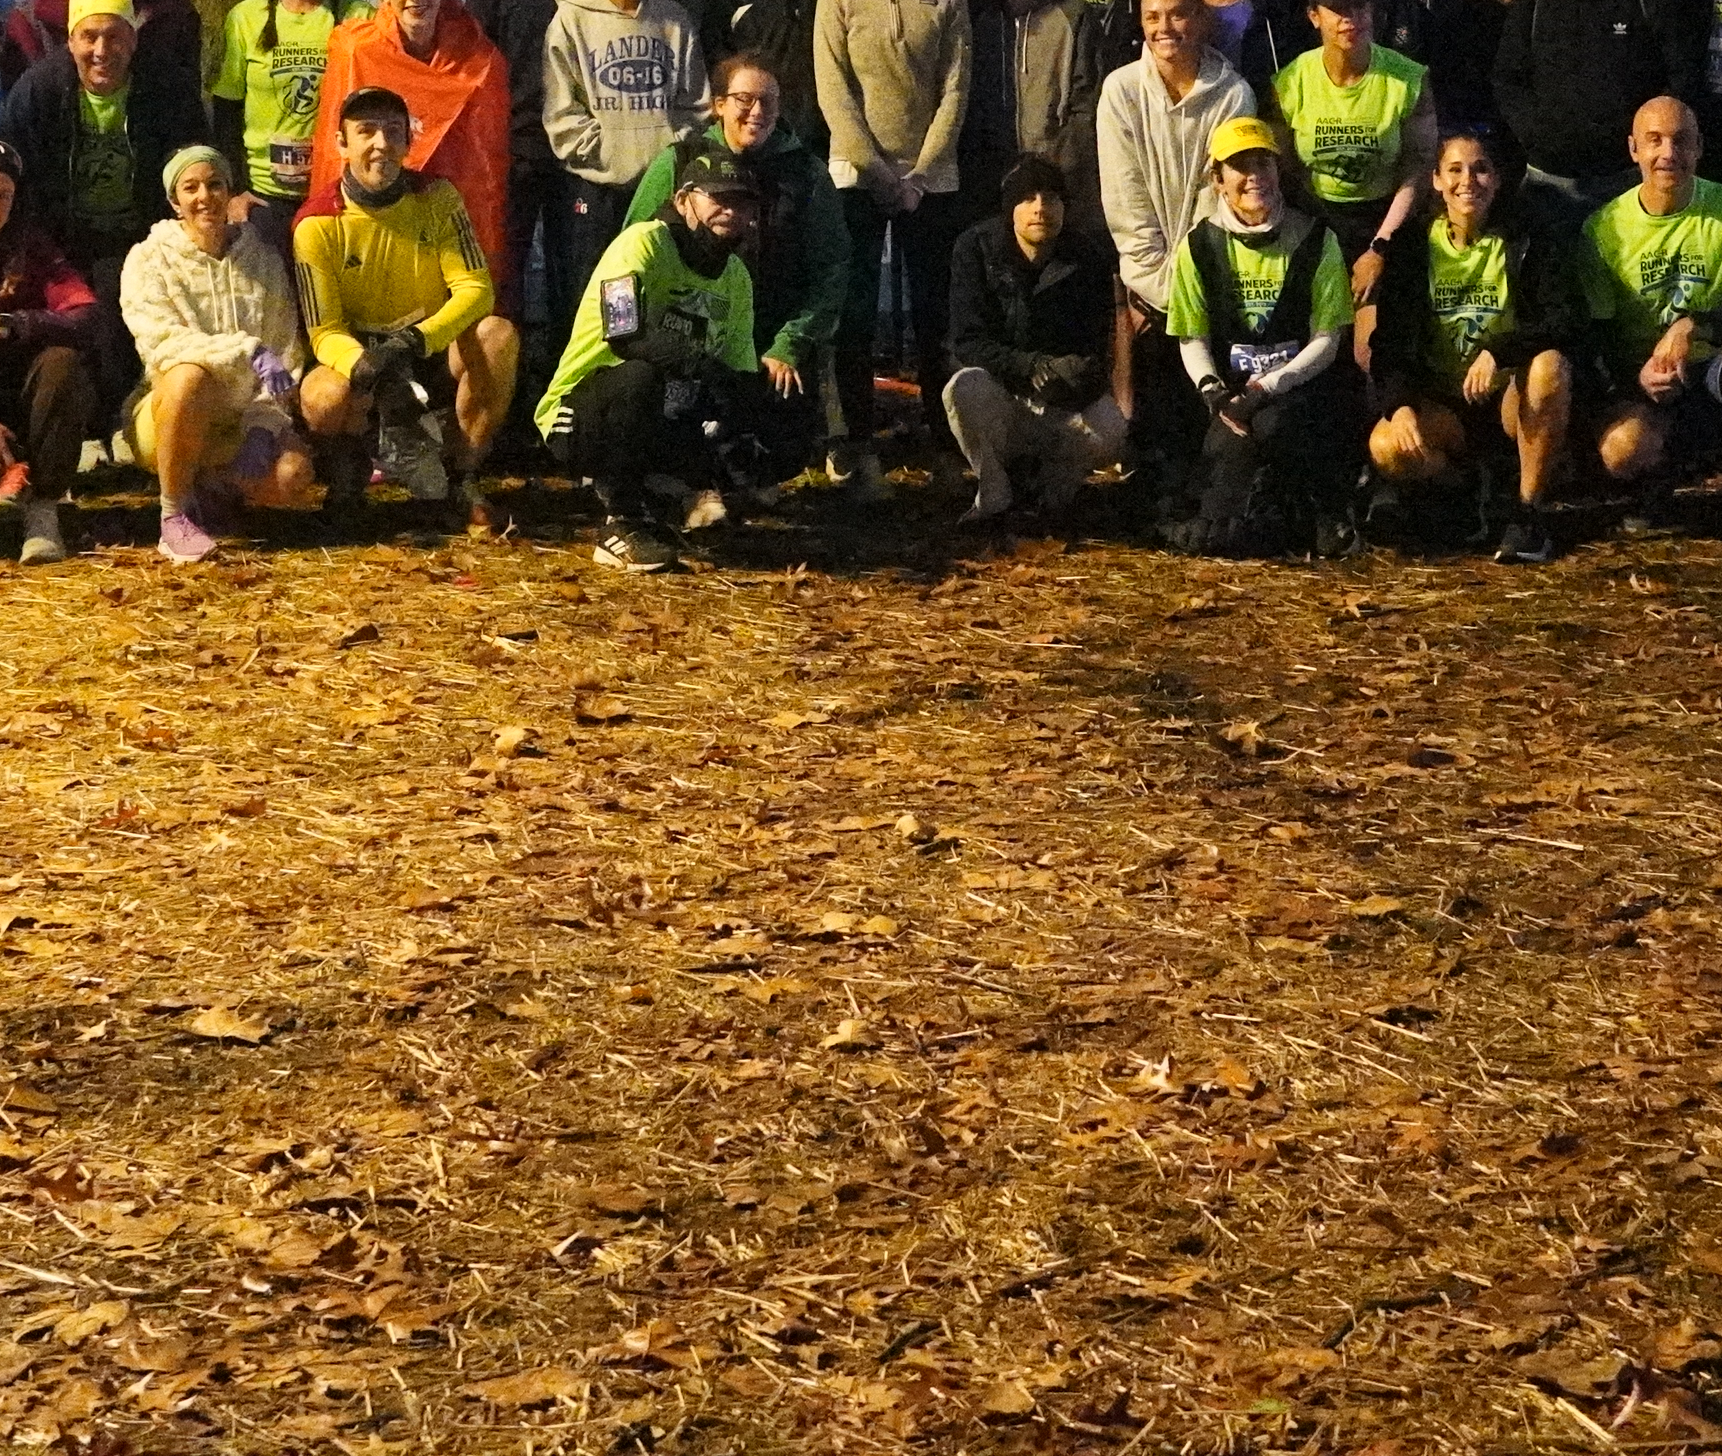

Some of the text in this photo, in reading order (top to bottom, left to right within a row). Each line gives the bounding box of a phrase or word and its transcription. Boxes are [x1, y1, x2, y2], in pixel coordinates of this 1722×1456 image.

[272, 47, 319, 58] RUNNERS
[608, 66, 663, 86] 06-16
[1316, 117, 1343, 125] AACR
[1315, 125, 1364, 136] RUNNERS
[1314, 135, 1379, 149] RESEARCH
[282, 151, 292, 161] H
[1641, 263, 1706, 286] RESERCH
[1434, 294, 1499, 309] RESARCH
